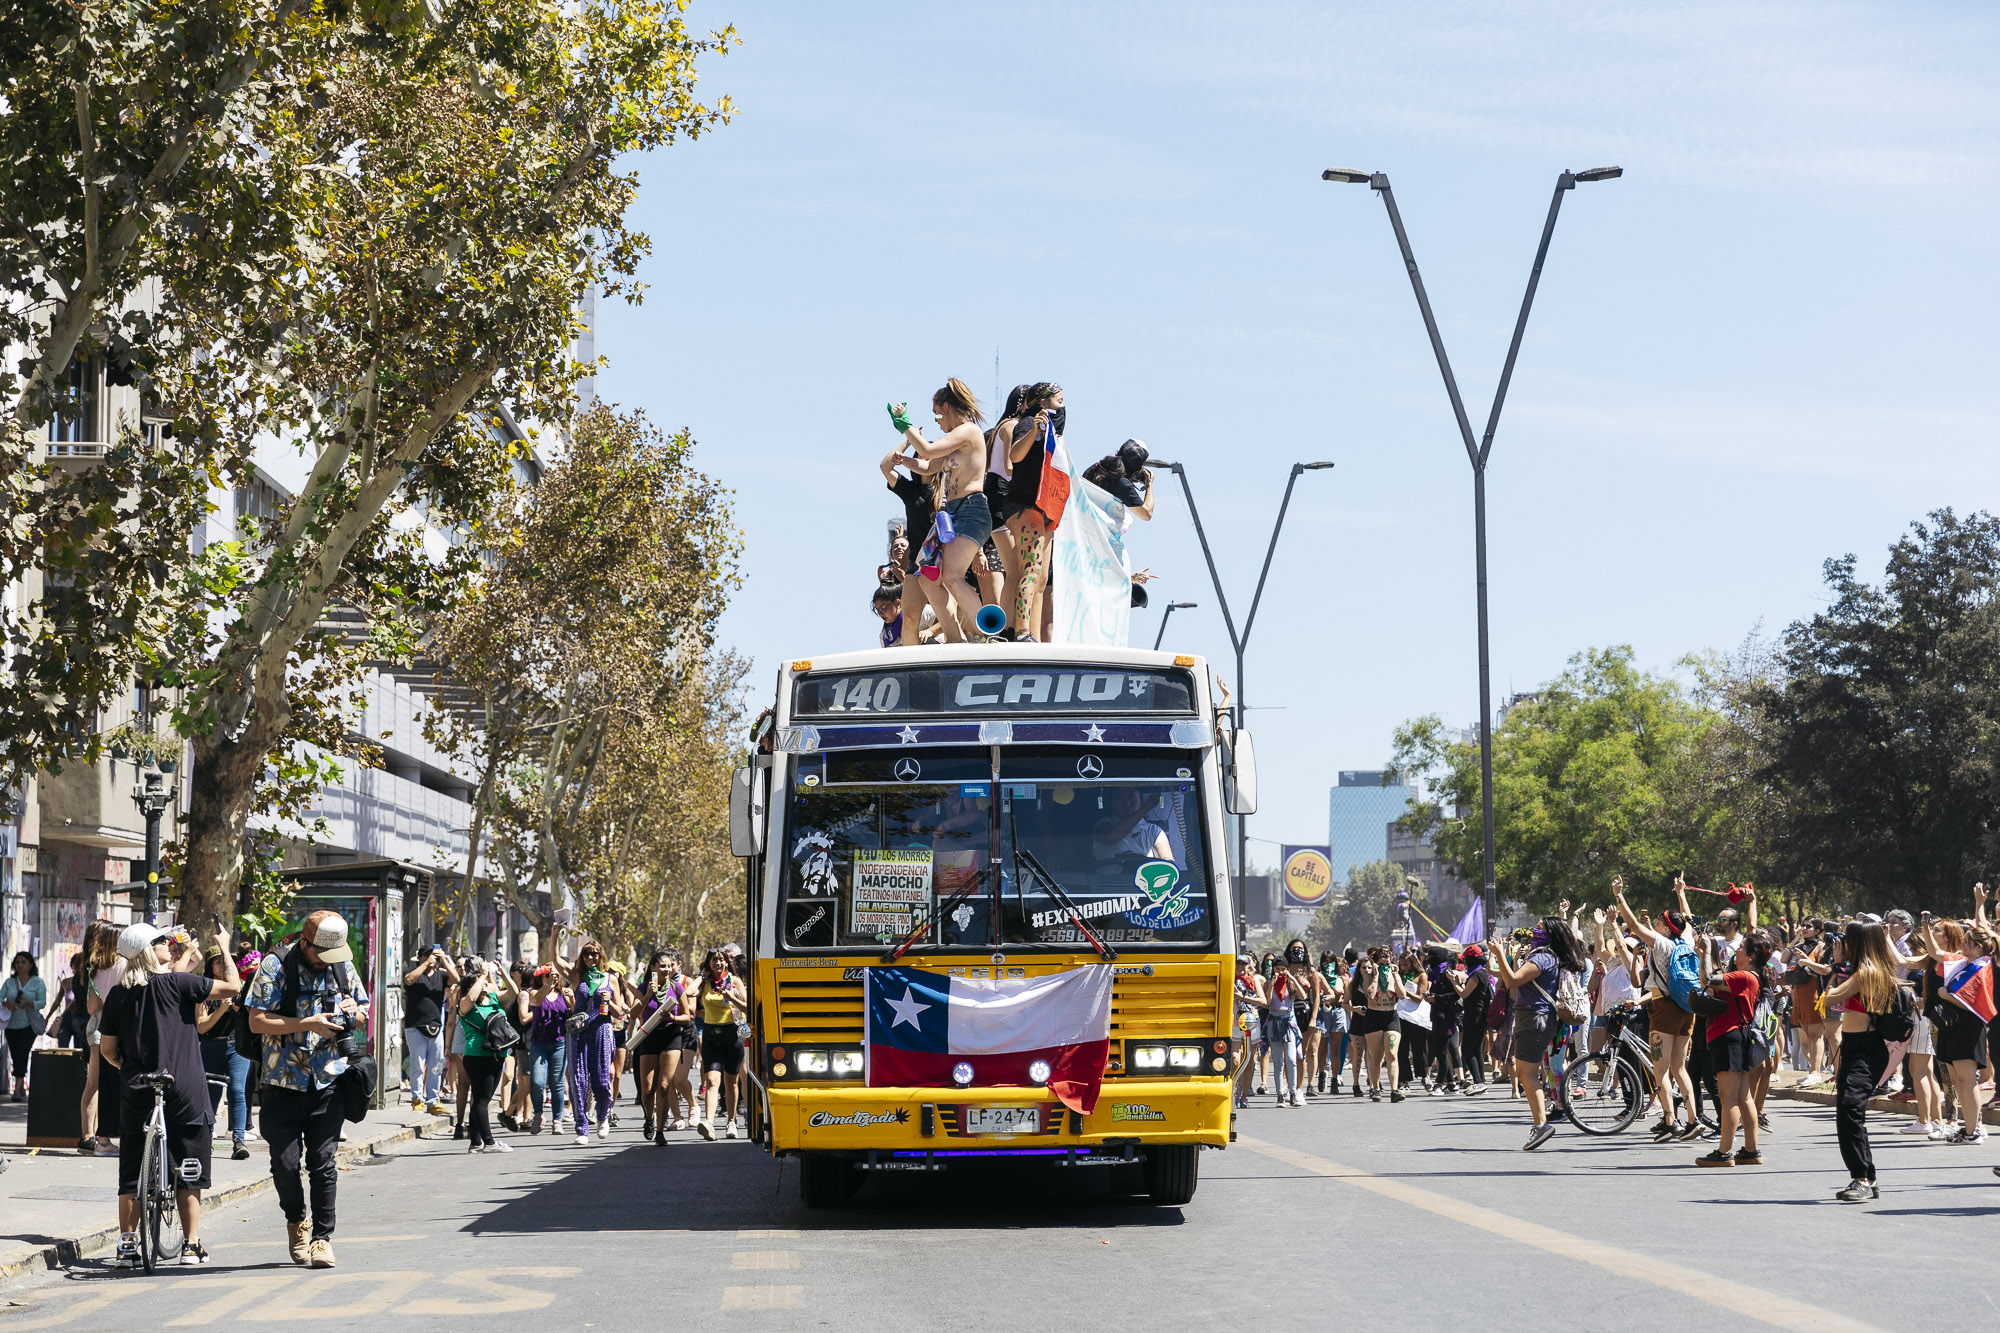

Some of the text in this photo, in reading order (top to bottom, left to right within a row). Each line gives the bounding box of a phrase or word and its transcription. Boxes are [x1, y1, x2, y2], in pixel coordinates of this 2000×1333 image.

[829, 674, 1124, 712] 140 CAIO
[898, 851, 931, 862] MORROS
[858, 863, 929, 876] INDEPENDENCIA
[1306, 861, 1316, 872] BE
[861, 875, 923, 889] MAPOCHO
[1291, 866, 1325, 885] CAPITALS
[793, 905, 826, 939] Bepo.cl
[855, 913, 866, 923] LOS
[1130, 911, 1147, 927] LOS
[1148, 918, 1160, 929] DE
[1161, 919, 1172, 929] LA
[1040, 929, 1075, 942] +569
[1106, 928, 1125, 942] 89
[780, 957, 839, 967] Mercedes-Benz
[1126, 1104, 1150, 1115] 100%
[1126, 1111, 1164, 1121] amarillas
[808, 1109, 897, 1127] Climatizado
